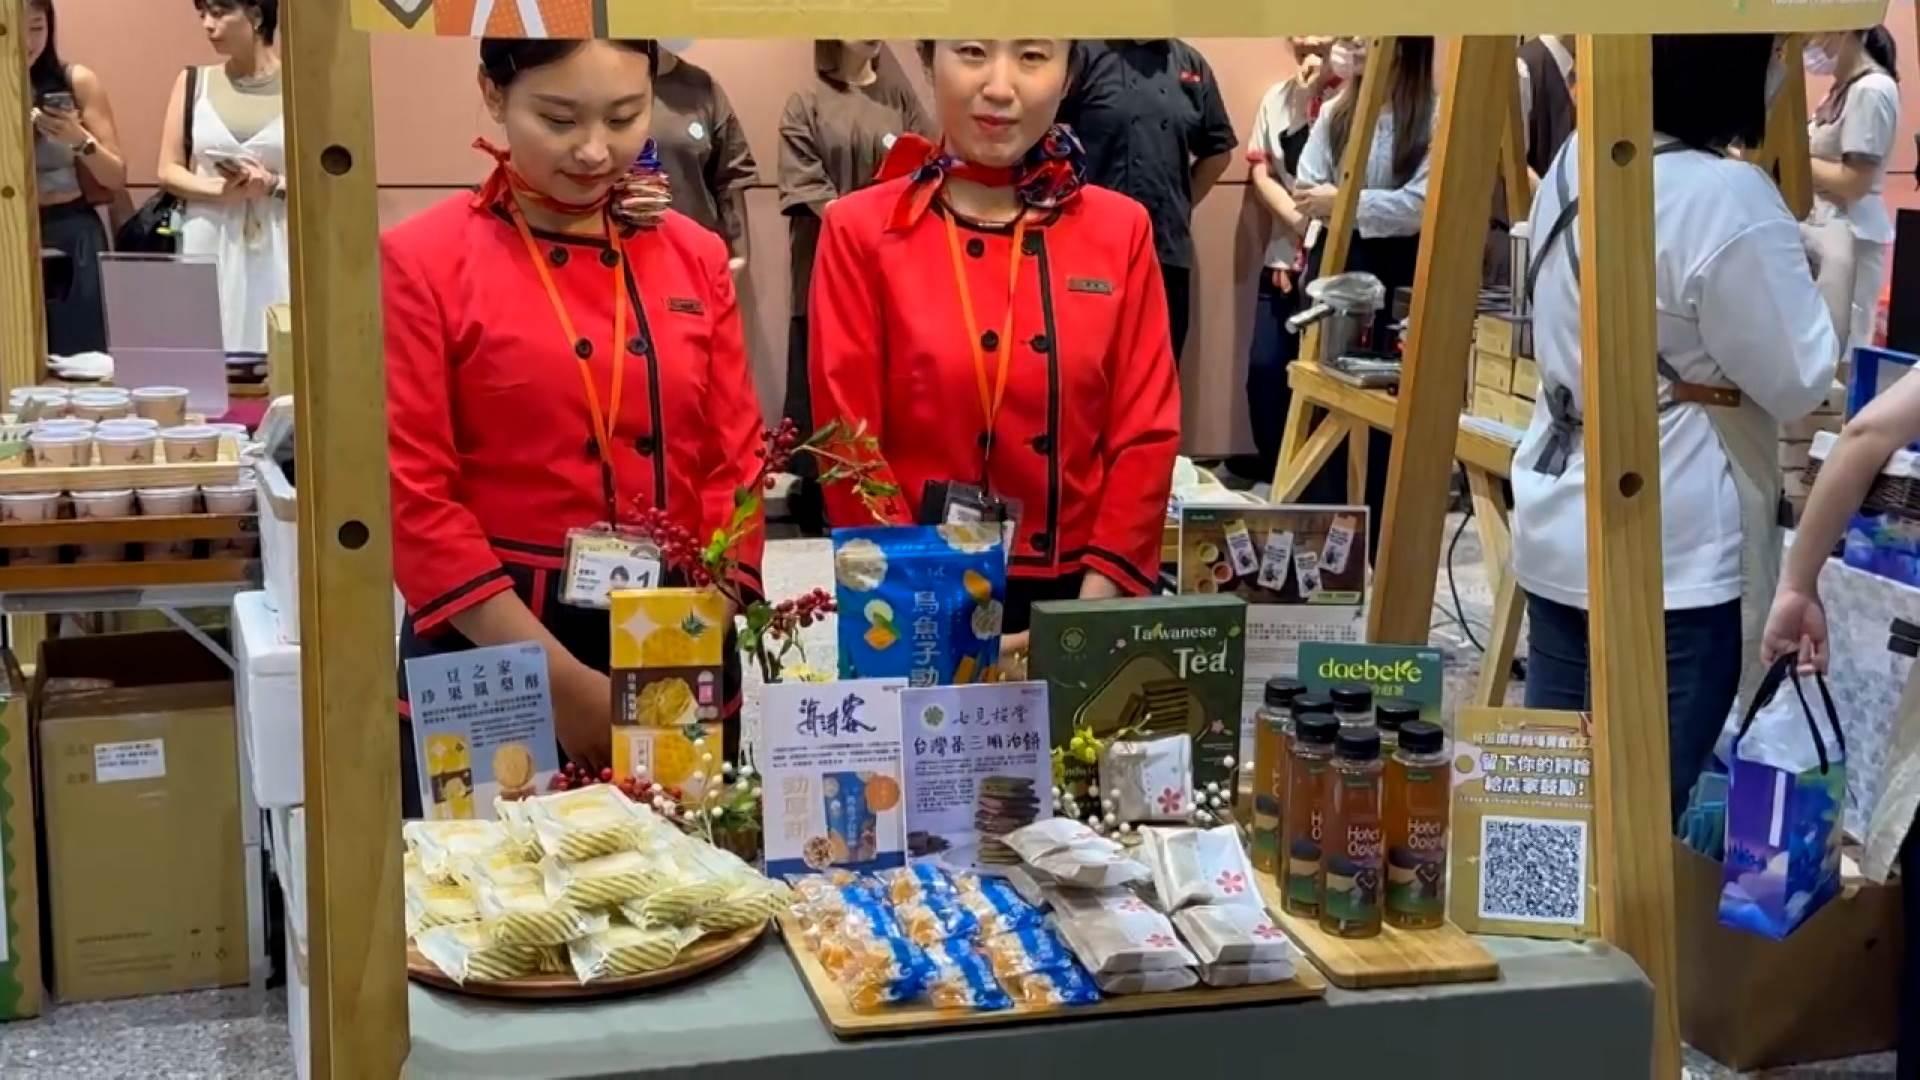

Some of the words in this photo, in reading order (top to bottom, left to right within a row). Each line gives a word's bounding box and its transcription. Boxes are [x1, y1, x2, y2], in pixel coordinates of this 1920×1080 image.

[1131, 624, 1217, 641] Taiwanese
[446, 659, 511, 684] 豆之家
[914, 729, 1041, 757] 台灣茶三明治餅
[1480, 752, 1591, 776] 留下你的評論
